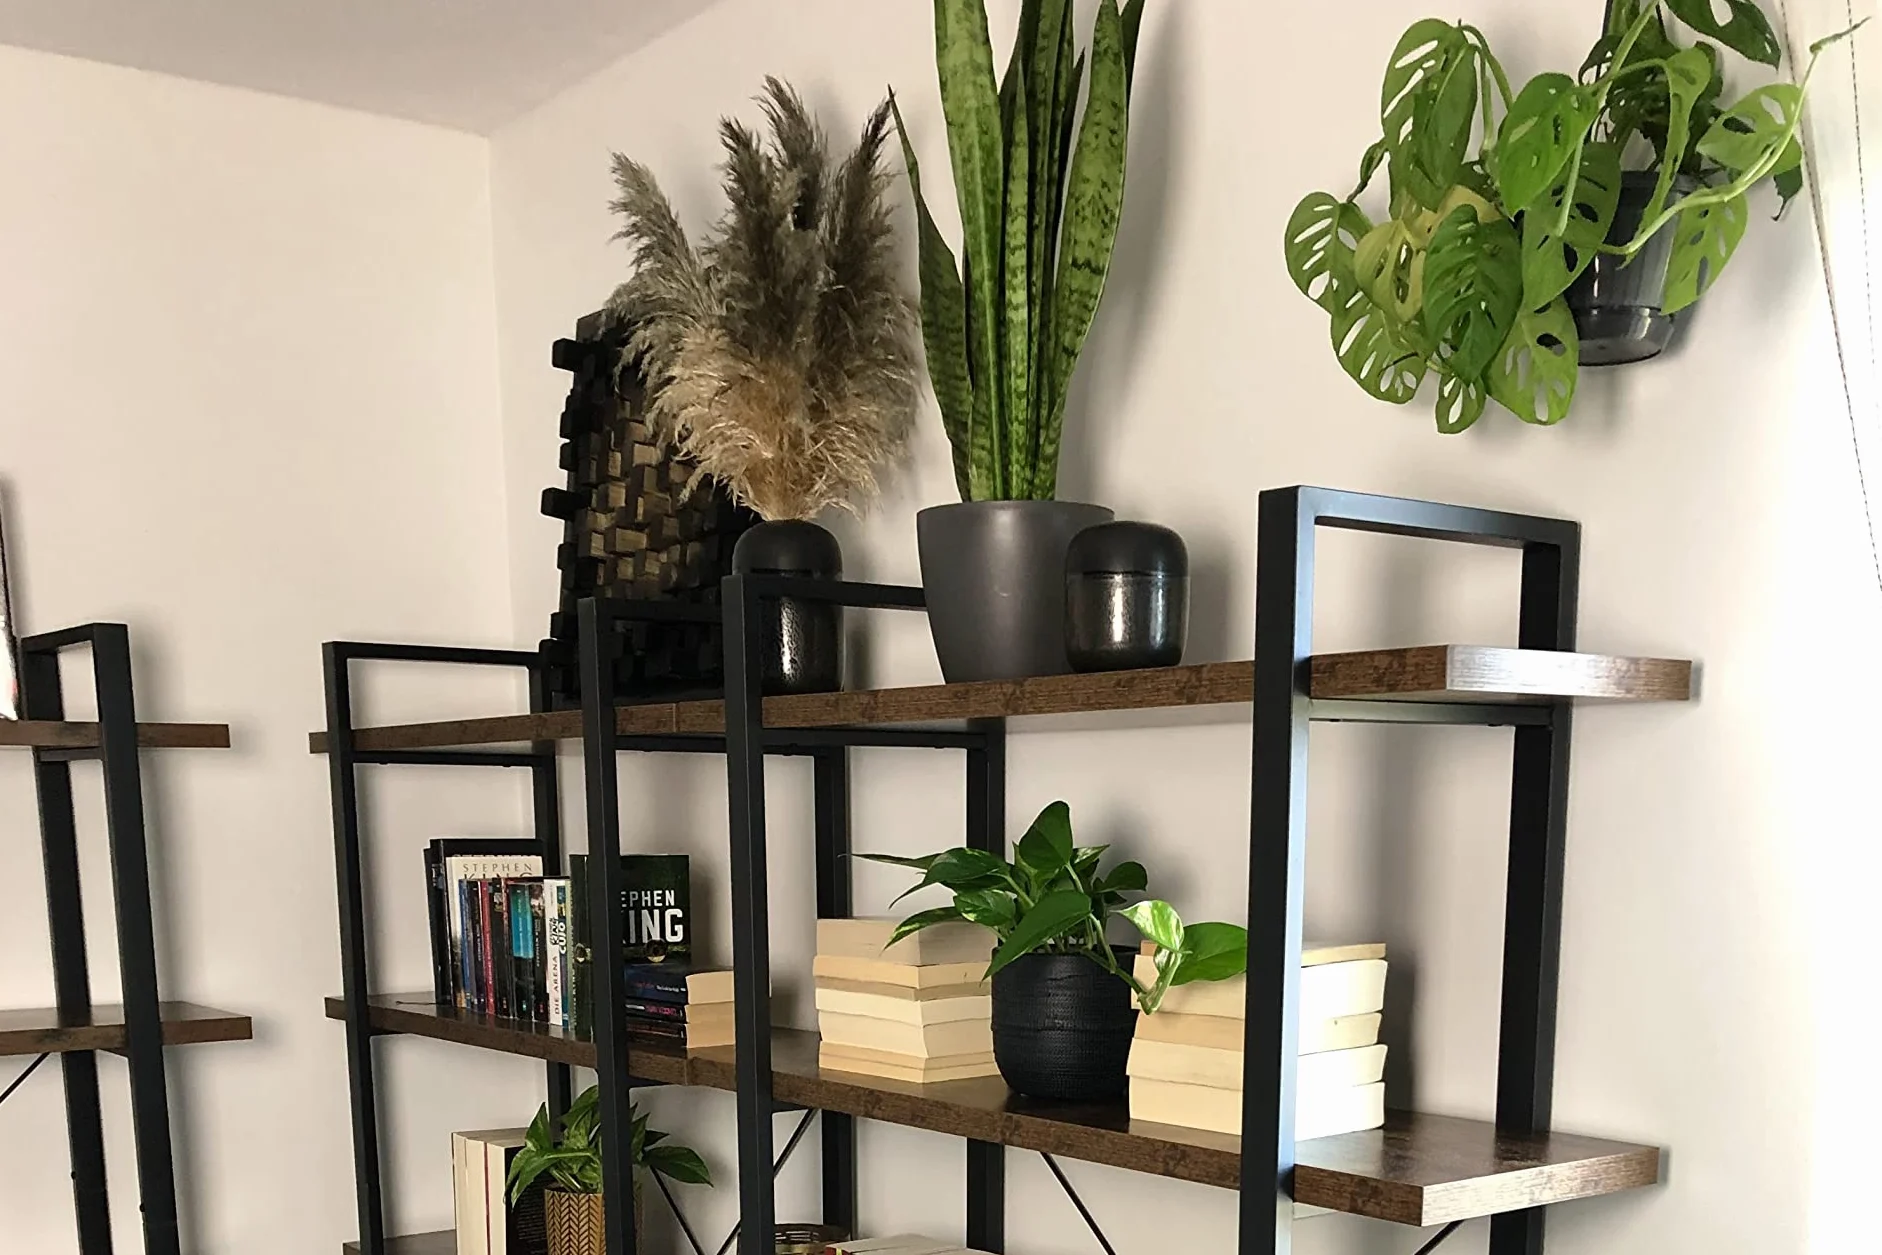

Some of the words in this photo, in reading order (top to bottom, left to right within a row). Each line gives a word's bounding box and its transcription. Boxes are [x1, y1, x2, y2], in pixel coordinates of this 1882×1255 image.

[463, 863, 533, 873] STEPHEN
[620, 890, 675, 907] EPHEN
[558, 922, 567, 954] CUJO
[620, 908, 684, 944] ING
